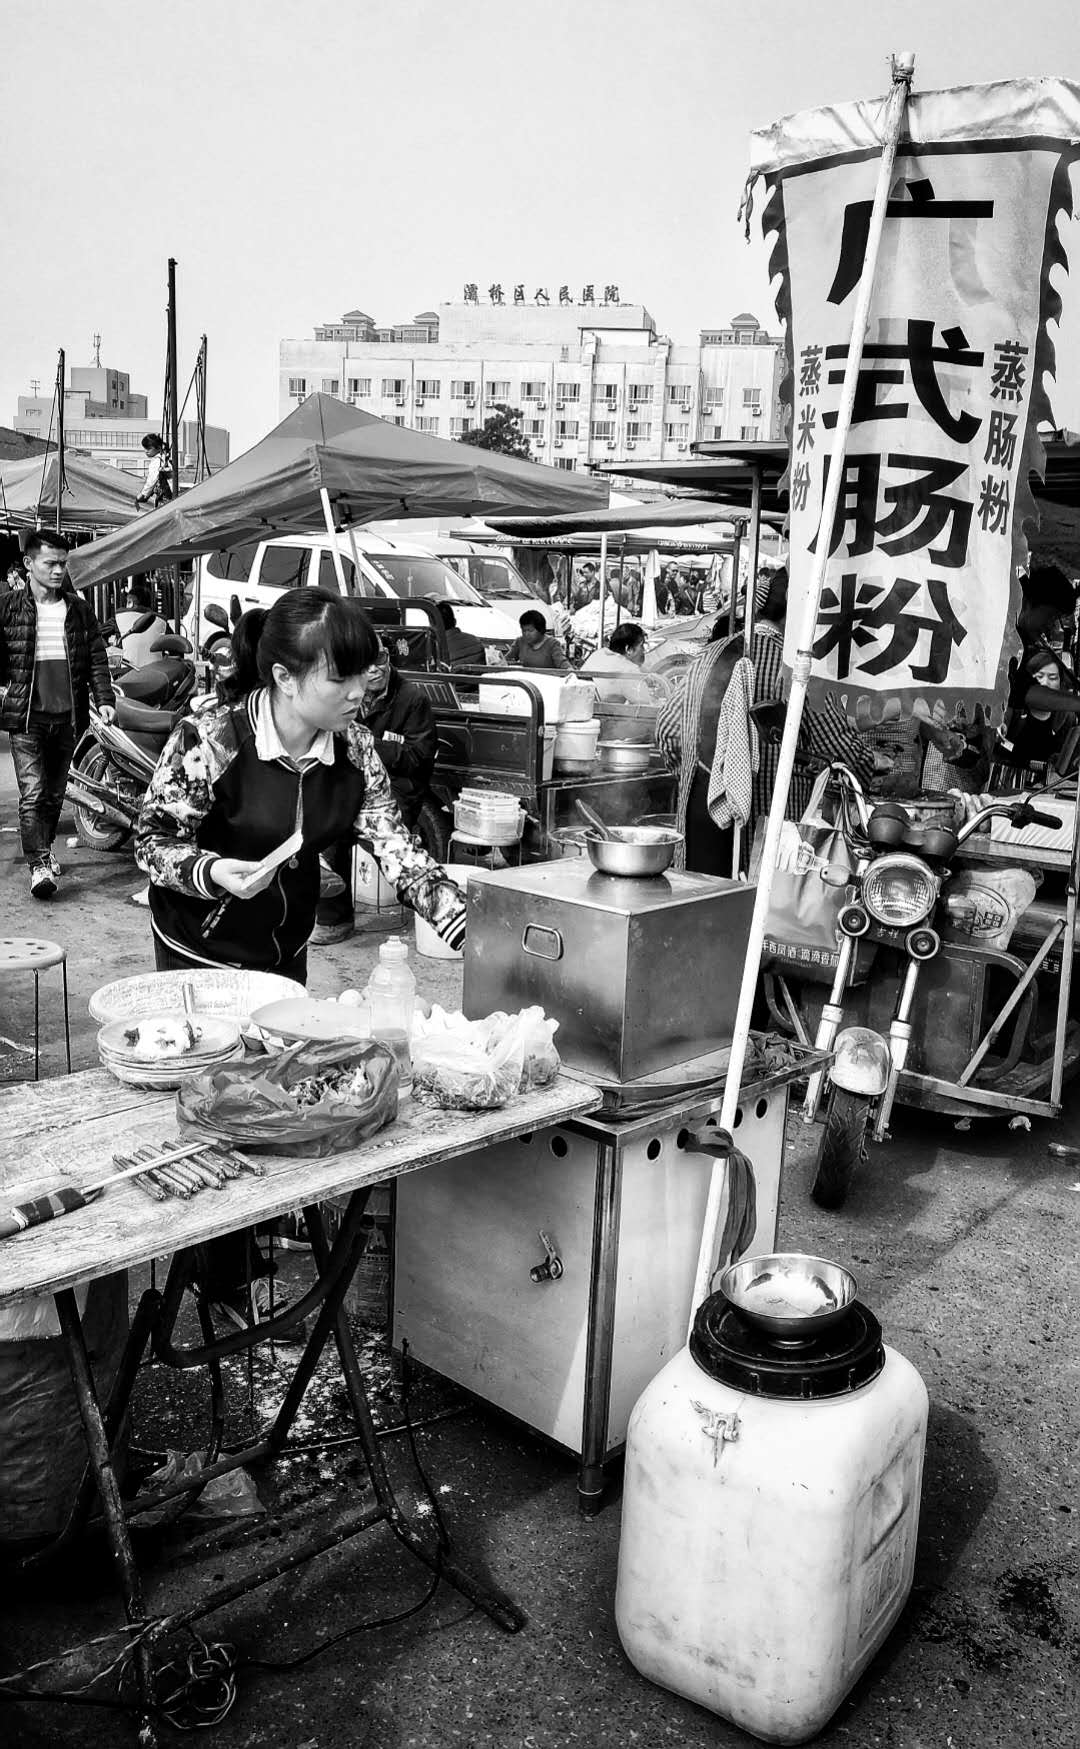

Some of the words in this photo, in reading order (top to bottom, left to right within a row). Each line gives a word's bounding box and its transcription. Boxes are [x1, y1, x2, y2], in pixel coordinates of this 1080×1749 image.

[464, 283, 620, 303] 灞桥区人民医院
[792, 345, 823, 511] 蒸米粉
[808, 178, 994, 684] 广式肠粉
[977, 340, 1029, 536] 蒸肠粉
